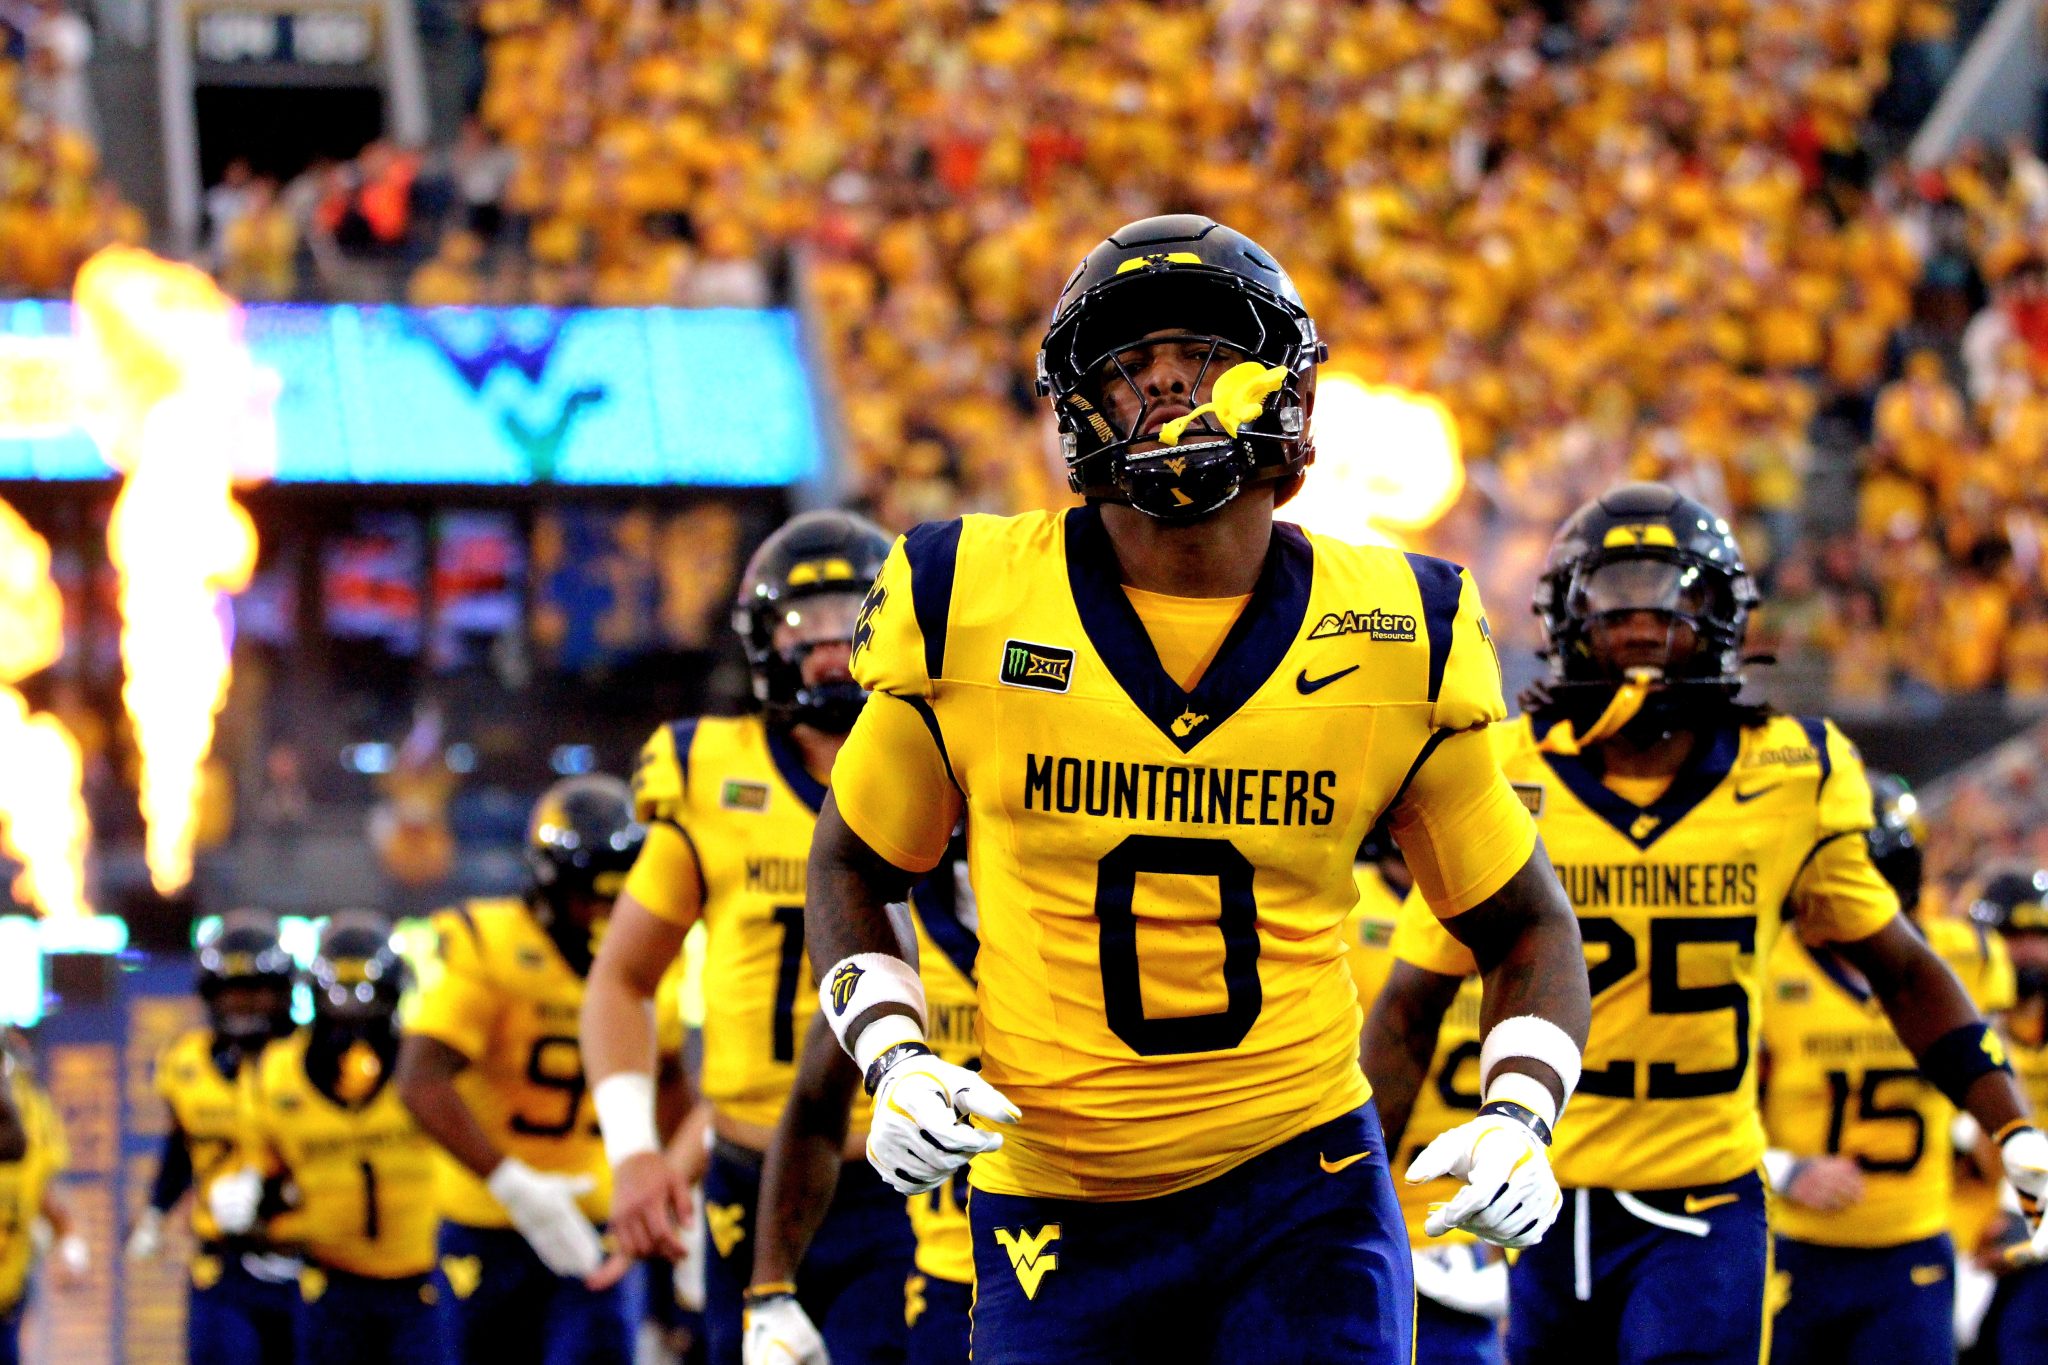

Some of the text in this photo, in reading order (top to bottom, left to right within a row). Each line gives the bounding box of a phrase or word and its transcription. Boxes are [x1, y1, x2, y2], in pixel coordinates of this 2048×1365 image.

[1086, 412, 1114, 443] ROADS
[1340, 608, 1416, 632] Antero
[1372, 631, 1414, 640] Resources
[1024, 753, 1336, 826] MOUNTAINEERS
[1094, 834, 1263, 1056] 0
[1827, 1068, 1926, 1174] 15
